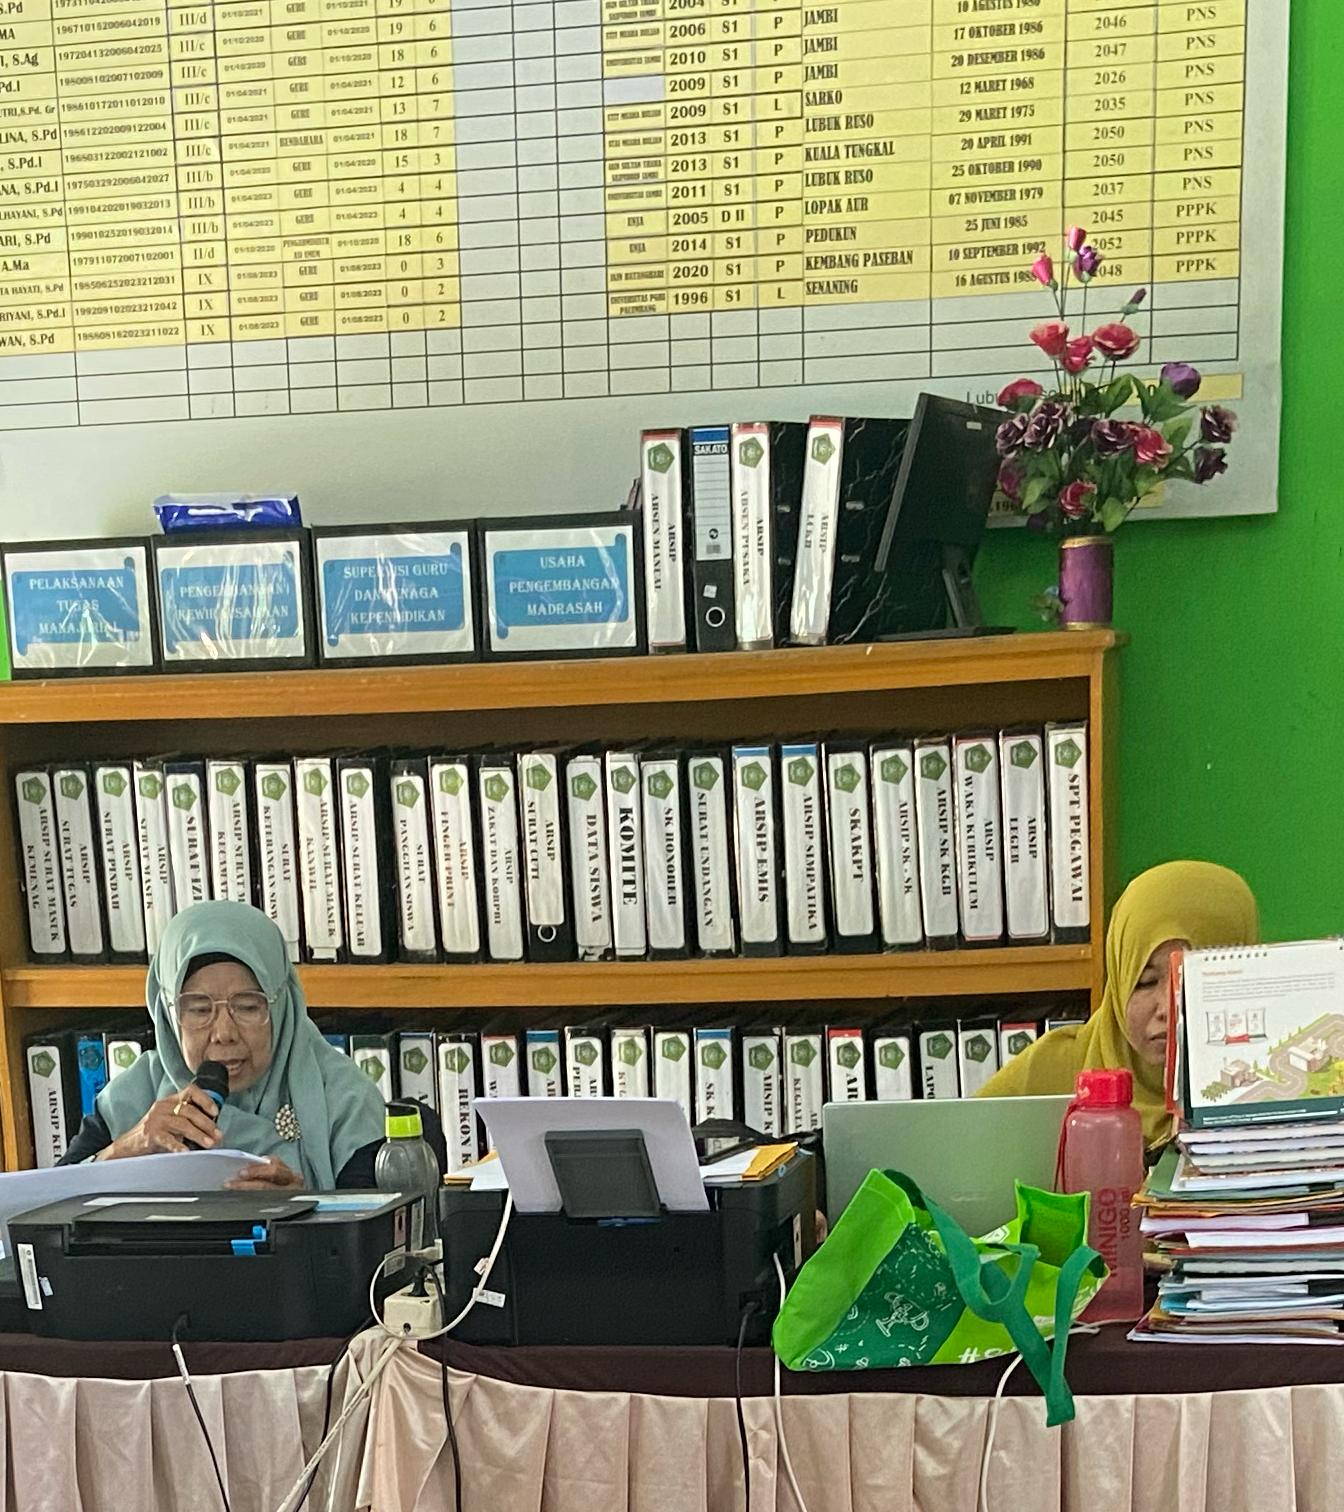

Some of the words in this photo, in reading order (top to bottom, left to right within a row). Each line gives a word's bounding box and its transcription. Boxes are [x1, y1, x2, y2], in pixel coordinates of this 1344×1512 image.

[804, 8, 838, 26] JAMBI
[1095, 16, 1127, 30] 2046
[1186, 7, 1216, 22] PNS
[12, 54, 39, 68] S.Ag
[670, 52, 706, 66] 2010
[31, 128, 57, 142] S.Pd
[671, 133, 706, 147] 2013
[1176, 203, 1216, 217] PPPK
[25, 233, 51, 245] S.Pd
[2, 260, 30, 272] A.Ma
[806, 253, 859, 270] KEMBANG
[863, 250, 913, 267] PASEBAN
[29, 333, 55, 346] S.Pd
[694, 444, 727, 454] SAKATO
[412, 563, 448, 576] GURU
[540, 555, 586, 568] USAHA
[509, 577, 619, 593] PENGEMBANGAN
[527, 602, 603, 616] MADRASAH
[39, 623, 119, 635] MANAJRIAL
[964, 775, 974, 820] WAKA
[1068, 773, 1081, 809] SPT
[664, 807, 674, 827] SK
[697, 792, 709, 840] SURAT
[803, 793, 814, 840] ARSIP
[937, 787, 948, 834] ARSIP
[754, 797, 767, 853] ARSIP
[899, 800, 910, 843] ARSIP
[586, 814, 598, 861] DATA
[984, 819, 994, 862] ARSIP
[1010, 817, 1019, 863] LEGER
[1027, 815, 1038, 860] ARSIP
[619, 807, 637, 905] KOMITE
[902, 847, 911, 865] SK
[939, 838, 949, 858] SK
[1070, 815, 1083, 902] PEGAWAI
[757, 859, 769, 903] EMIS
[904, 877, 913, 895] SK
[940, 863, 951, 895] KGB
[191, 878, 203, 901] IZI
[588, 866, 602, 923] SISWA
[269, 892, 278, 921] SISW
[706, 1082, 715, 1100] SK
[763, 1072, 773, 1117] ARSIP
[48, 1088, 60, 1130] ARSIP
[794, 1078, 802, 1132] KEGIATA
[458, 1088, 472, 1147] REKON
